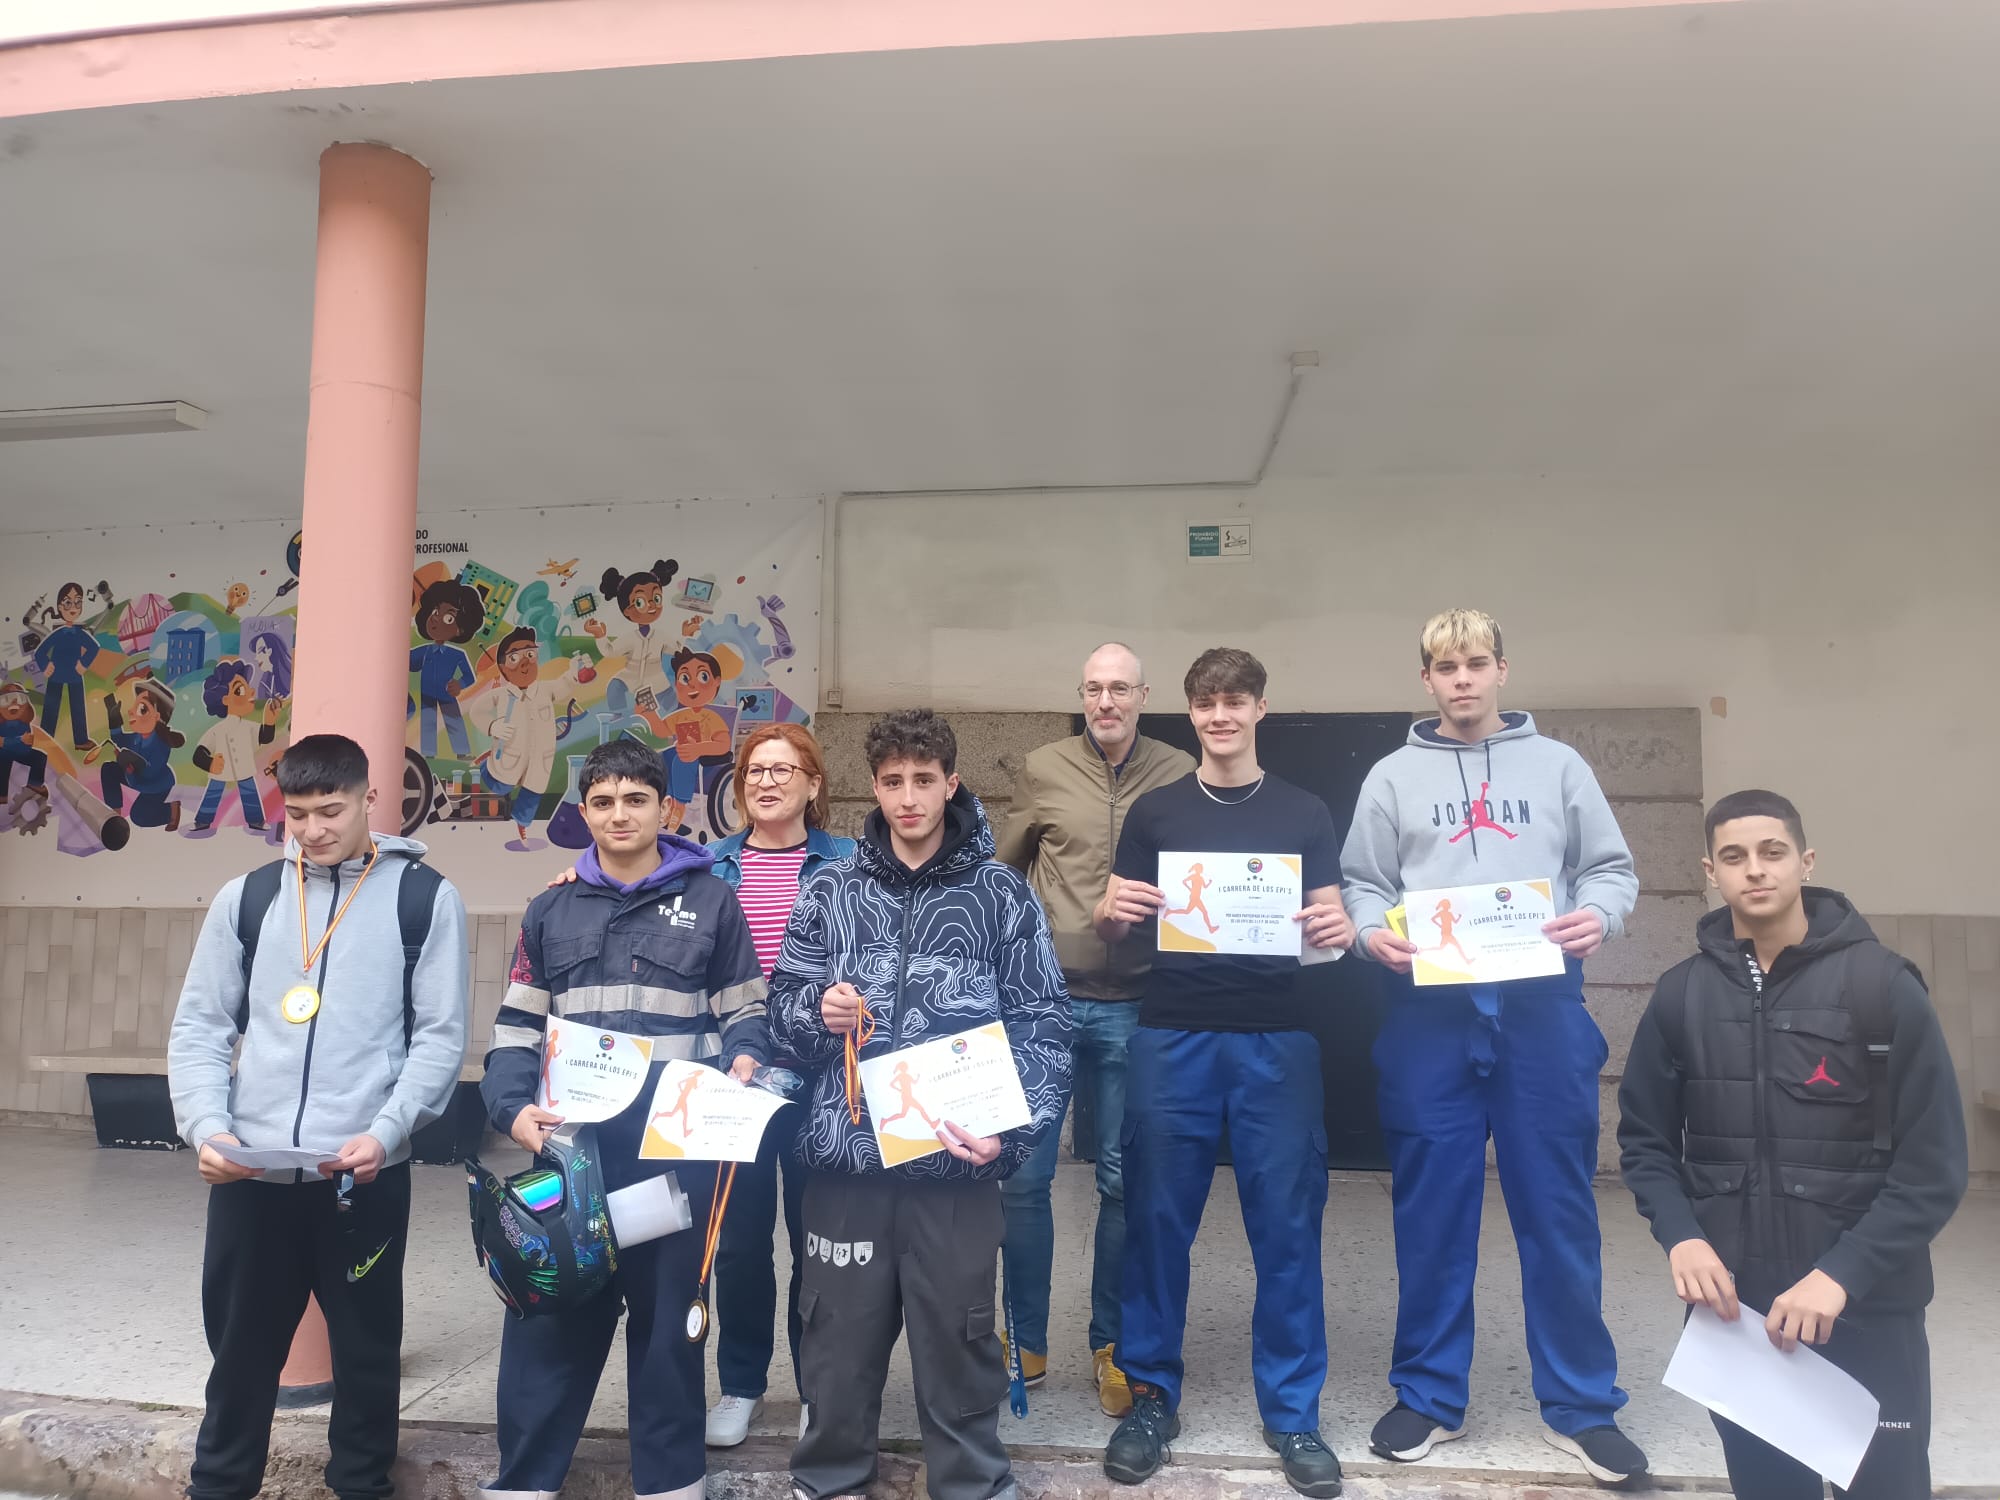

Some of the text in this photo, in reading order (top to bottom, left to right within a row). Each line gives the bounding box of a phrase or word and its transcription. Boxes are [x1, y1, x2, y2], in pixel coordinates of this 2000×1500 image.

[414, 542, 469, 554] ROFESIONAL
[1223, 885, 1251, 893] CARRERA
[1262, 885, 1274, 893] LOS
[1473, 914, 1502, 926] CARRERA
[1504, 913, 1513, 921] DE
[569, 1058, 598, 1069] CARRERA
[600, 1063, 608, 1071] DE
[609, 1065, 620, 1075] LOS
[1879, 1420, 1912, 1429] KENZIE
